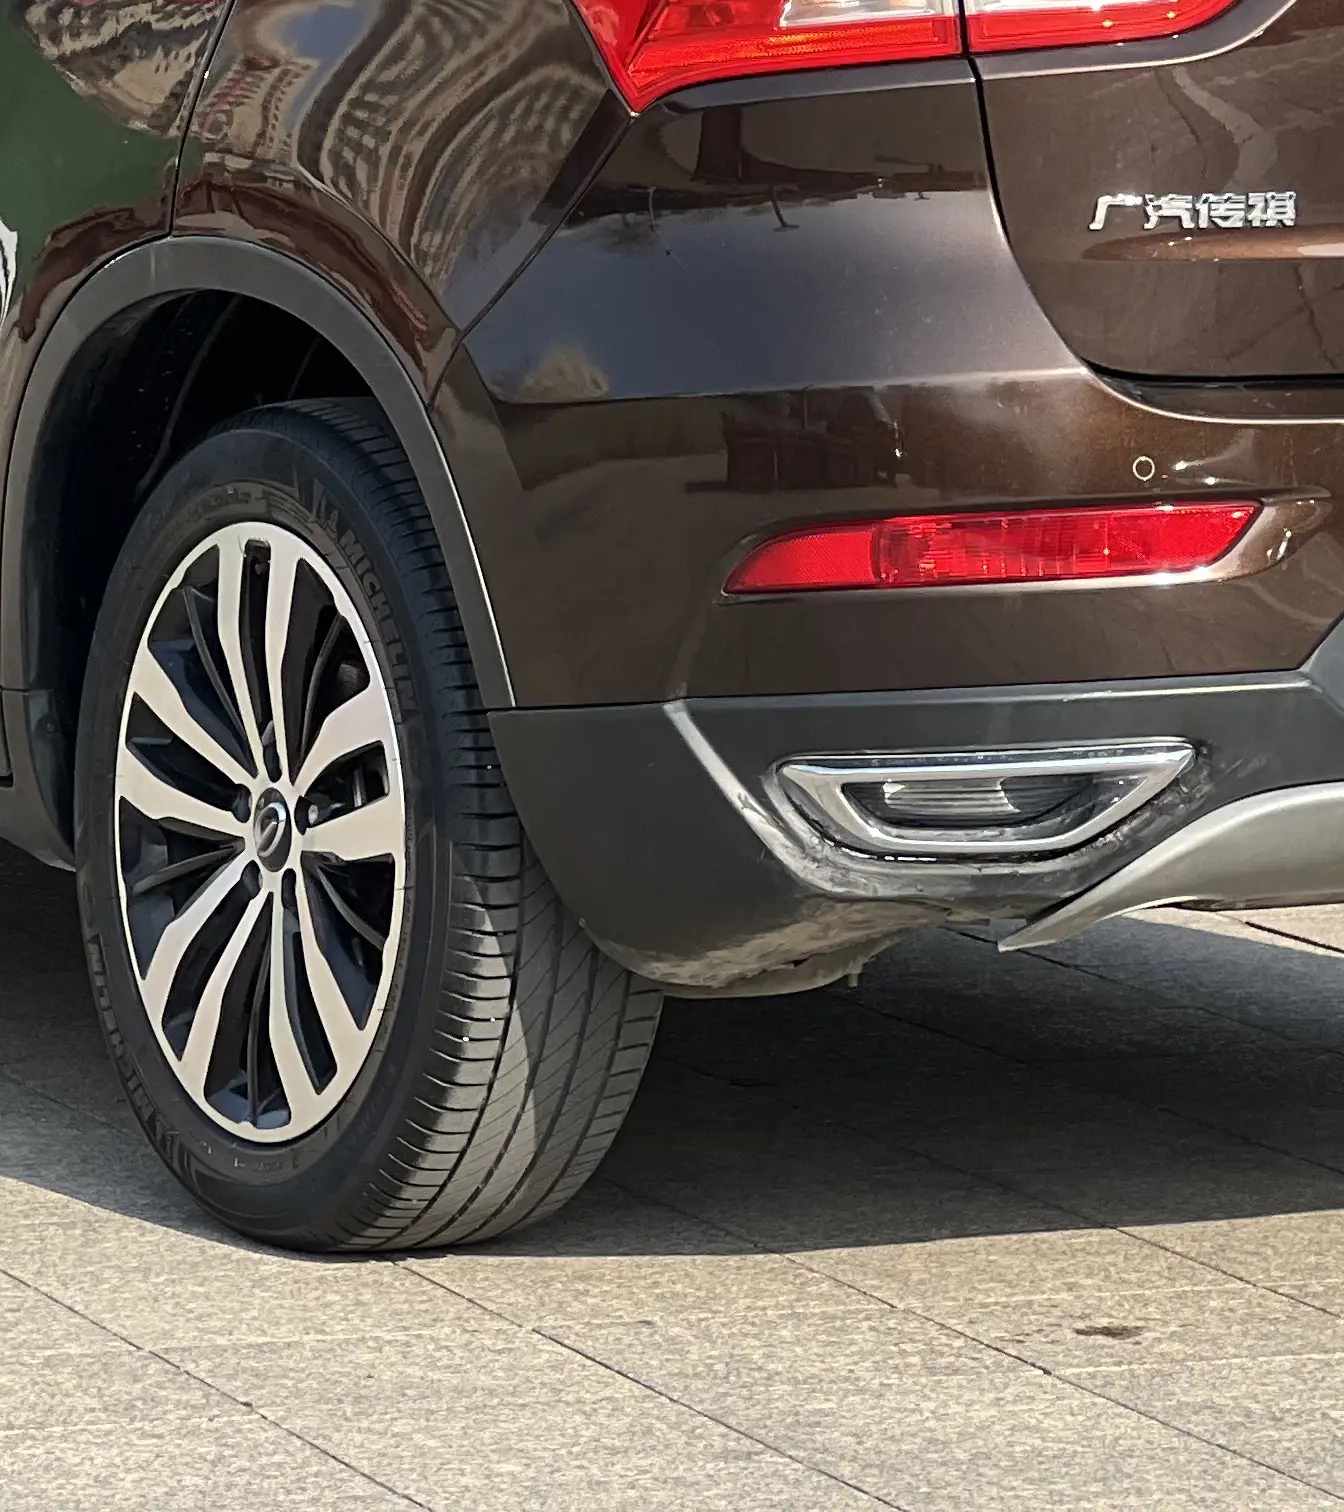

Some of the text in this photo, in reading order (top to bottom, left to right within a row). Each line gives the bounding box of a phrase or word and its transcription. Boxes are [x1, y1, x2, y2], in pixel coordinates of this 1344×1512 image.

[1089, 191, 1297, 230] 广汽传祺
[339, 529, 419, 711] MICHELIN
